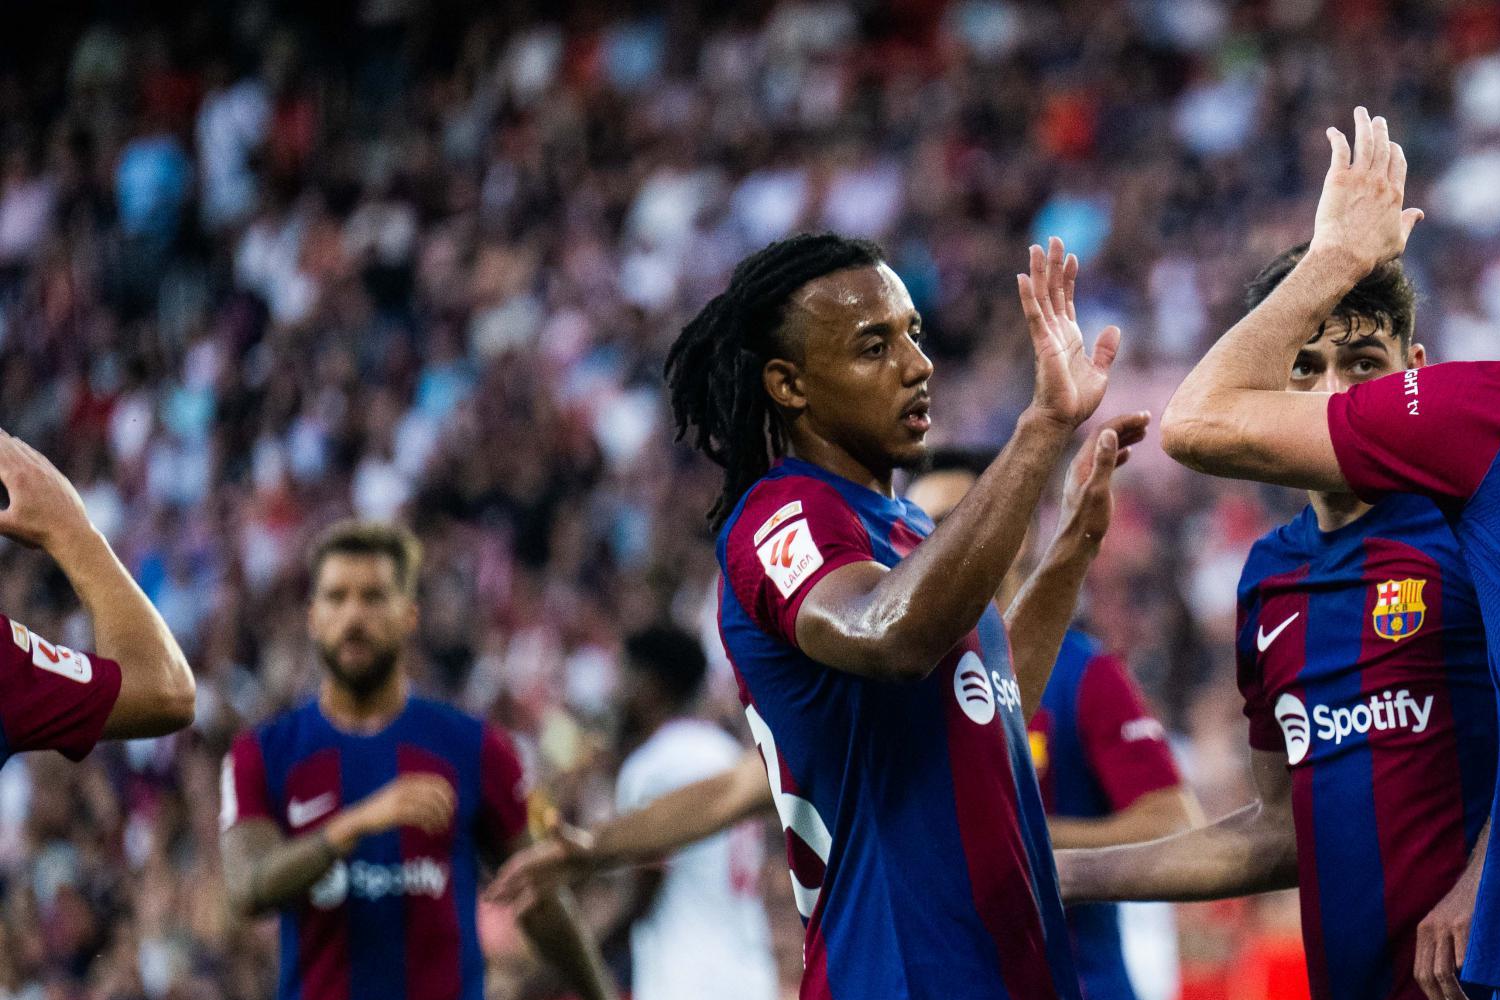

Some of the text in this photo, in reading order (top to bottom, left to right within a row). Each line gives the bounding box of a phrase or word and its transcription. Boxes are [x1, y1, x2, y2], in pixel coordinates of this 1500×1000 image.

[1407, 399, 1420, 416] tv
[783, 553, 814, 589] LALIGA
[1312, 689, 1435, 745] Spotify
